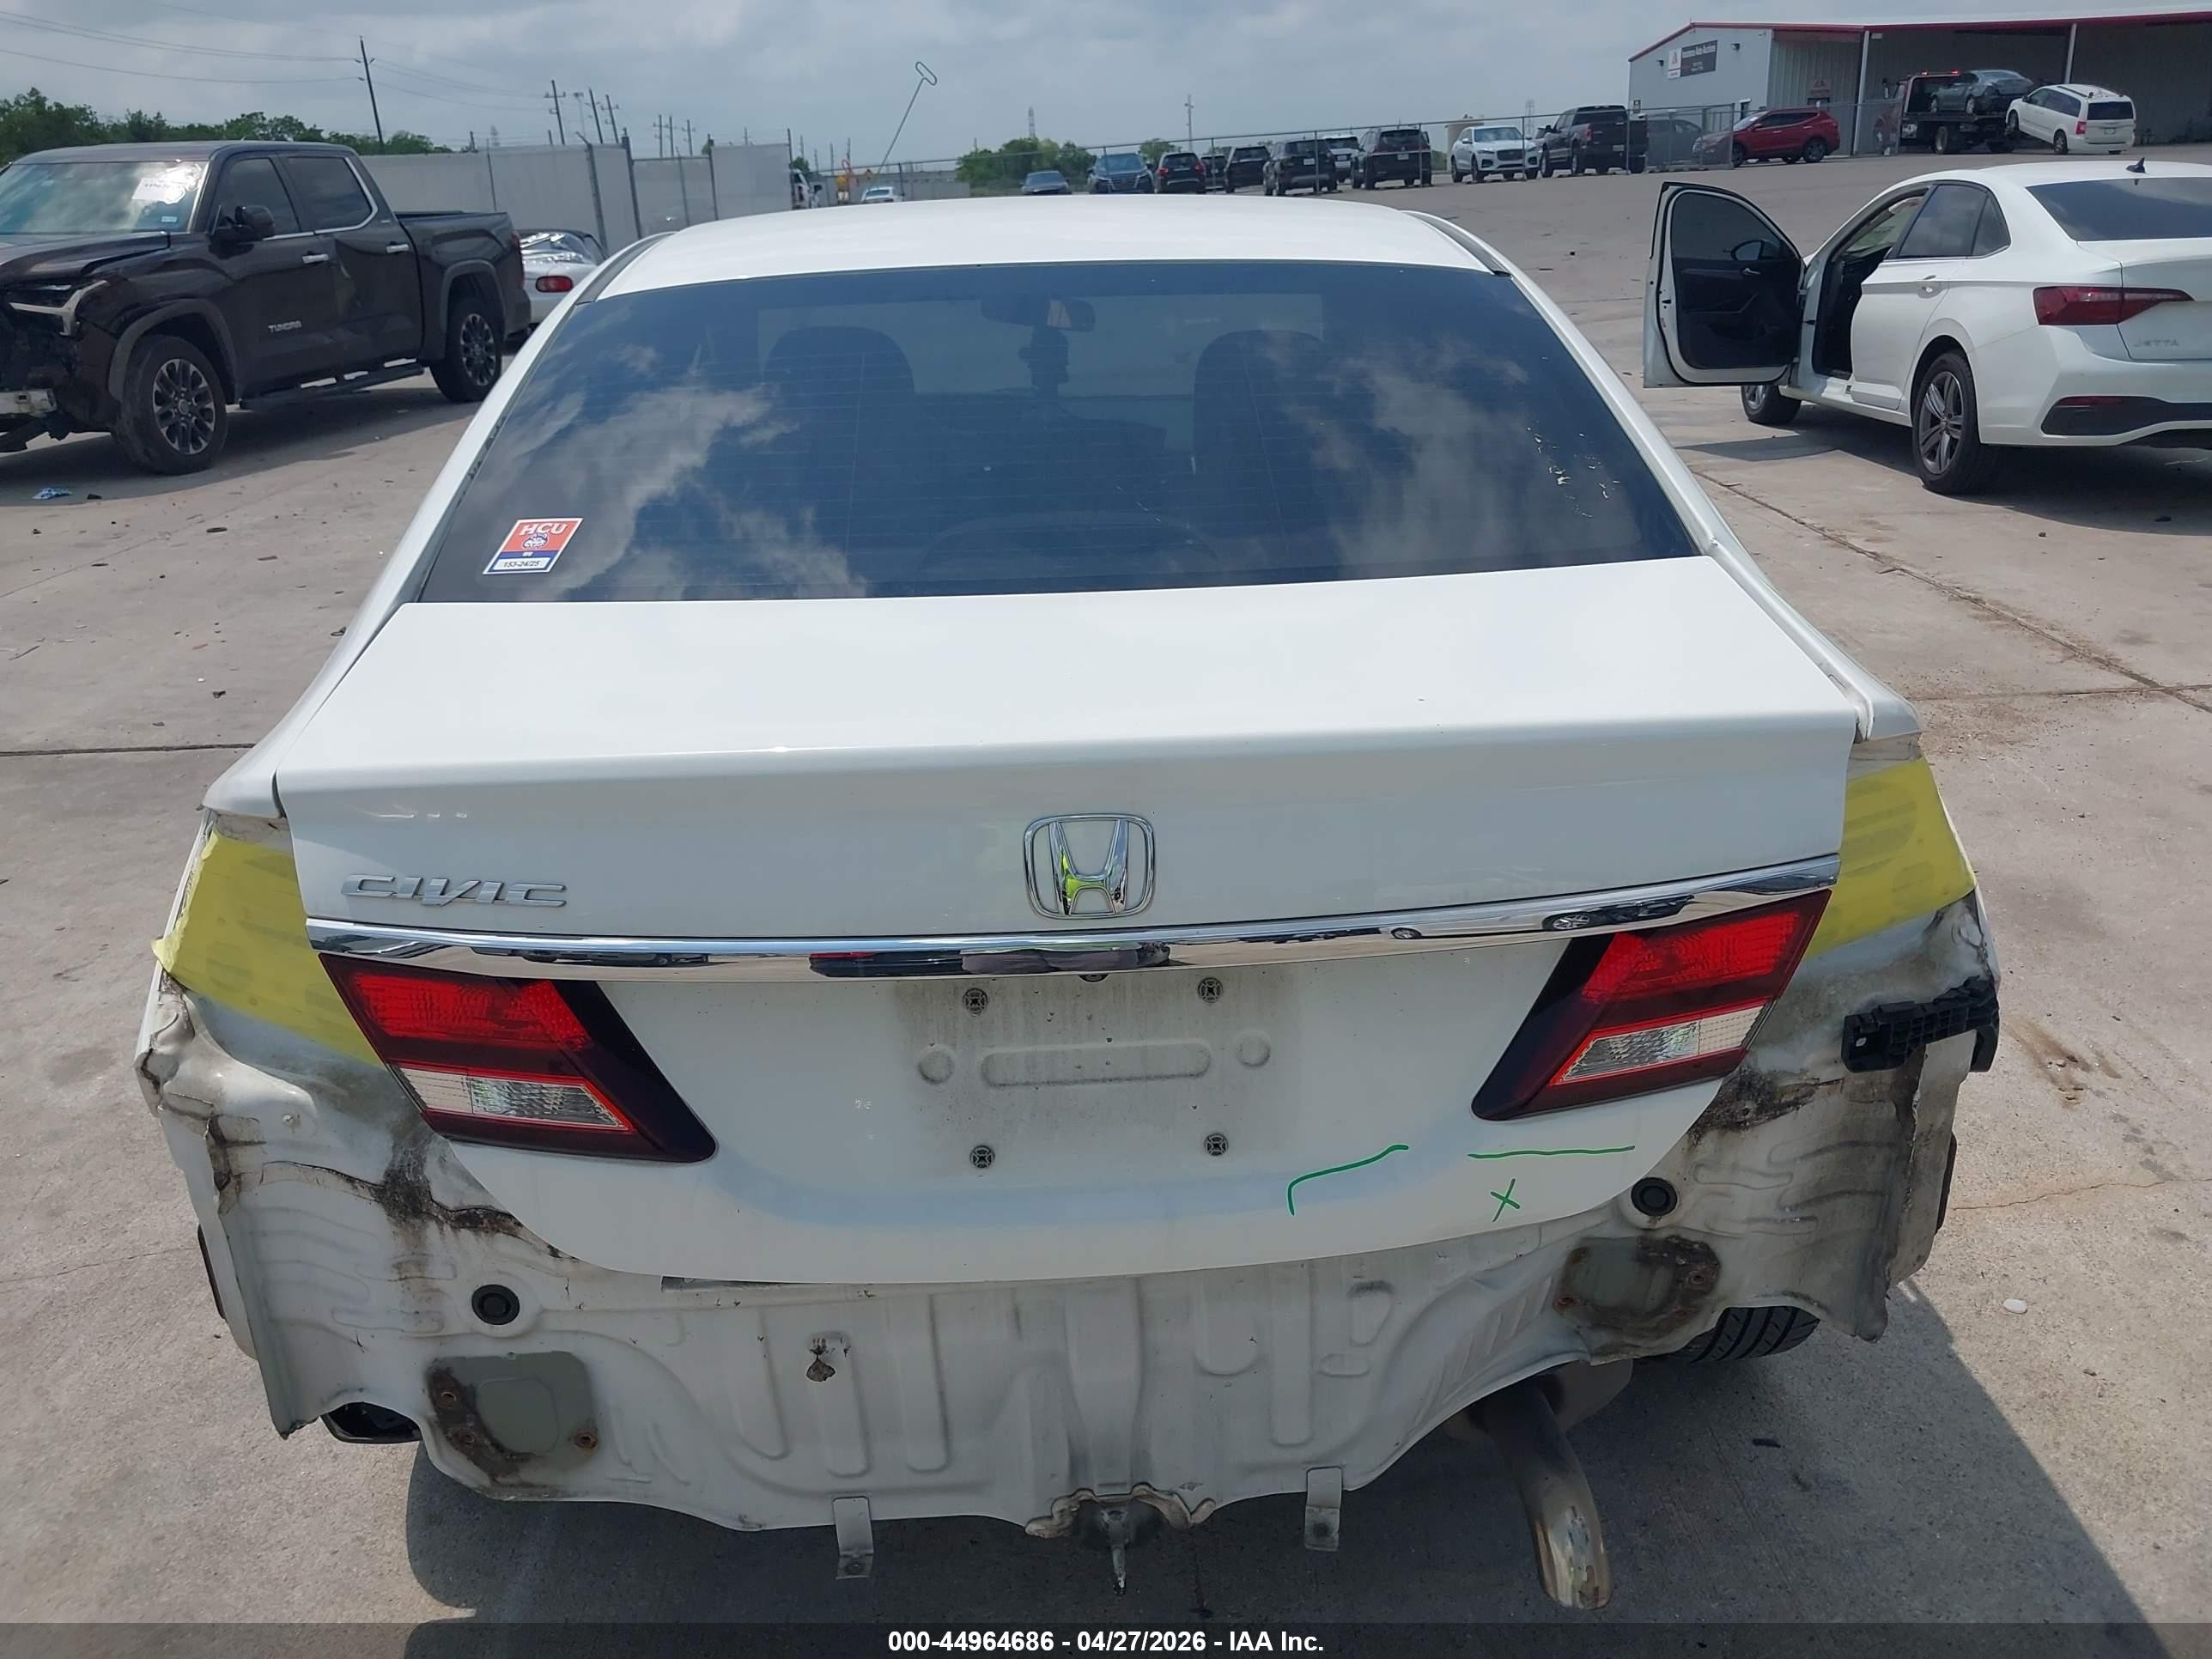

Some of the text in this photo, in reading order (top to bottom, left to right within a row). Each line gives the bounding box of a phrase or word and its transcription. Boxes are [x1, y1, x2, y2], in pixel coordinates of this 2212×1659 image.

[268, 320, 302, 333] TUNDRA
[520, 522, 568, 536] HCU
[341, 873, 567, 908] CIVIC
